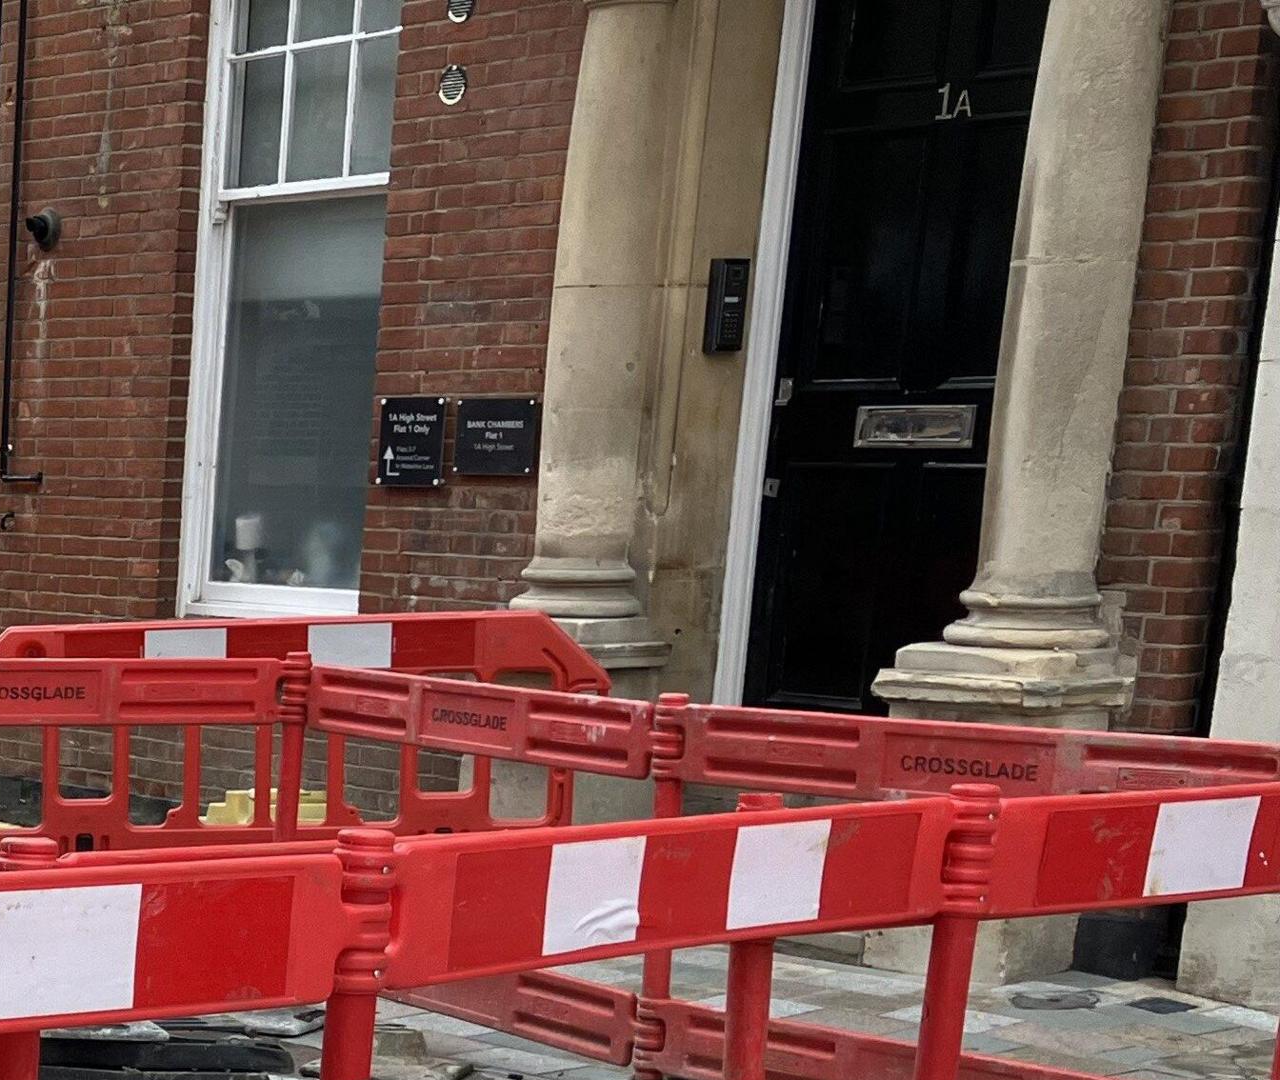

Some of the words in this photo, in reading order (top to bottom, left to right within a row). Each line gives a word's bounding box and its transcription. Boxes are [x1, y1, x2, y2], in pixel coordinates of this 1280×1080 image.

[935, 82, 972, 120] 1A
[389, 413, 397, 422] 1A
[399, 413, 414, 424] High
[416, 413, 437, 422] Street
[393, 425, 406, 433] Flat
[408, 425, 412, 433] 1
[414, 425, 430, 435] Only
[467, 420, 486, 429] BANK
[487, 420, 524, 429] CHAMBERS
[485, 431, 497, 440] Flat
[431, 706, 508, 733] CROSSGLADE
[900, 754, 1038, 782] CROSSGLADE
